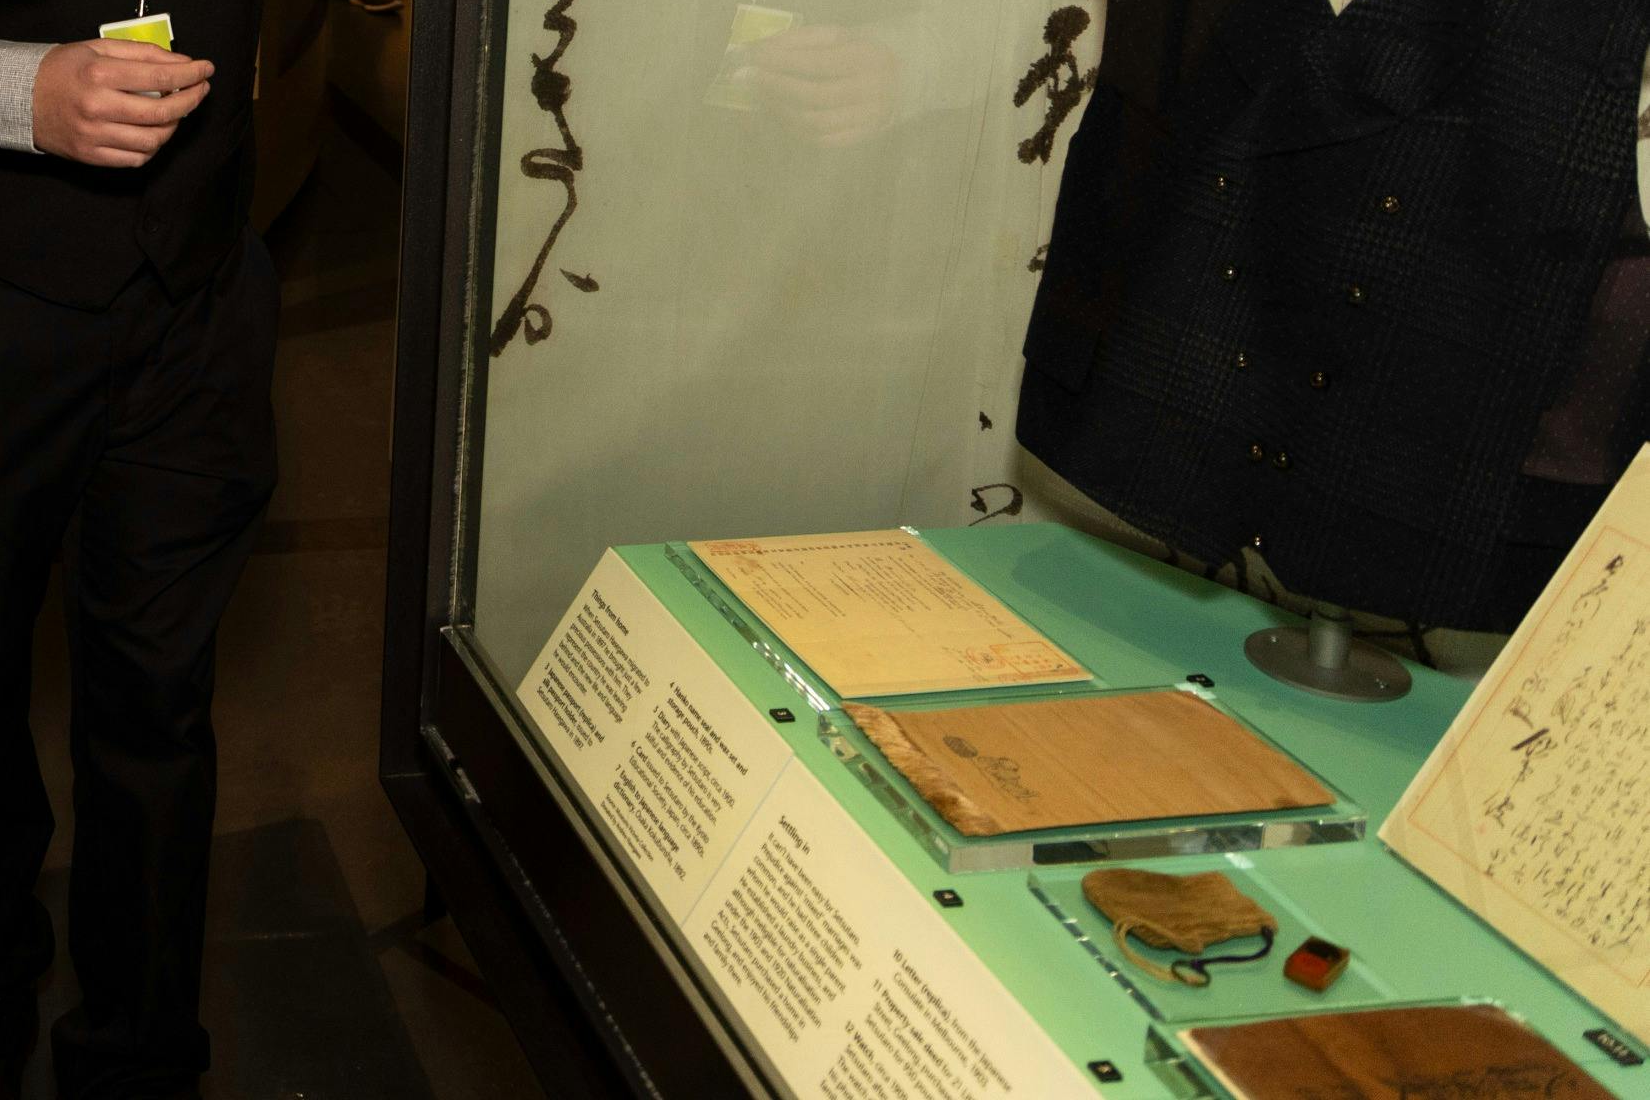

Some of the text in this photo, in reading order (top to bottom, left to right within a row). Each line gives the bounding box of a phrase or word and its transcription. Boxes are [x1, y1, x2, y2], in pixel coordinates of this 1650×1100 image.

[576, 613, 592, 633] Australia
[591, 630, 596, 638] in
[595, 635, 606, 647] 1897
[603, 645, 610, 655] he
[608, 651, 625, 673] brought
[621, 671, 632, 682] just
[633, 681, 641, 694] few
[582, 603, 650, 686] When Setsutaro Hasegawa migrated to
[591, 589, 628, 636] Things from home
[544, 662, 549, 670] 3
[547, 667, 565, 691] Japanese
[562, 689, 581, 712] passport
[594, 730, 604, 743] and
[667, 697, 684, 719] storage
[681, 717, 698, 738] pouch,
[673, 686, 688, 706] Hanko
[687, 704, 701, 721] name
[700, 719, 711, 732] seal
[709, 730, 720, 743] and
[719, 741, 729, 754] wax
[728, 753, 737, 764] set
[735, 762, 748, 775] and
[635, 746, 648, 762] Card
[645, 760, 660, 778] issued
[658, 775, 664, 785] to
[663, 781, 682, 808] Setsutaro
[681, 806, 688, 818] by
[688, 814, 696, 827] the
[652, 705, 658, 713] 5
[657, 710, 670, 729] Diary
[669, 727, 680, 740] with
[678, 737, 698, 762] Japanese
[710, 777, 722, 793] circa
[652, 720, 721, 812] The calligraphy by Setsutaro is very
[615, 763, 678, 851] 7 English to Japanese language
[778, 815, 809, 854] Settling in
[893, 949, 902, 962] 10
[901, 959, 921, 984] Letter
[950, 1018, 968, 1041] from
[967, 1039, 980, 1055] the
[979, 1053, 1010, 1091] Japanese
